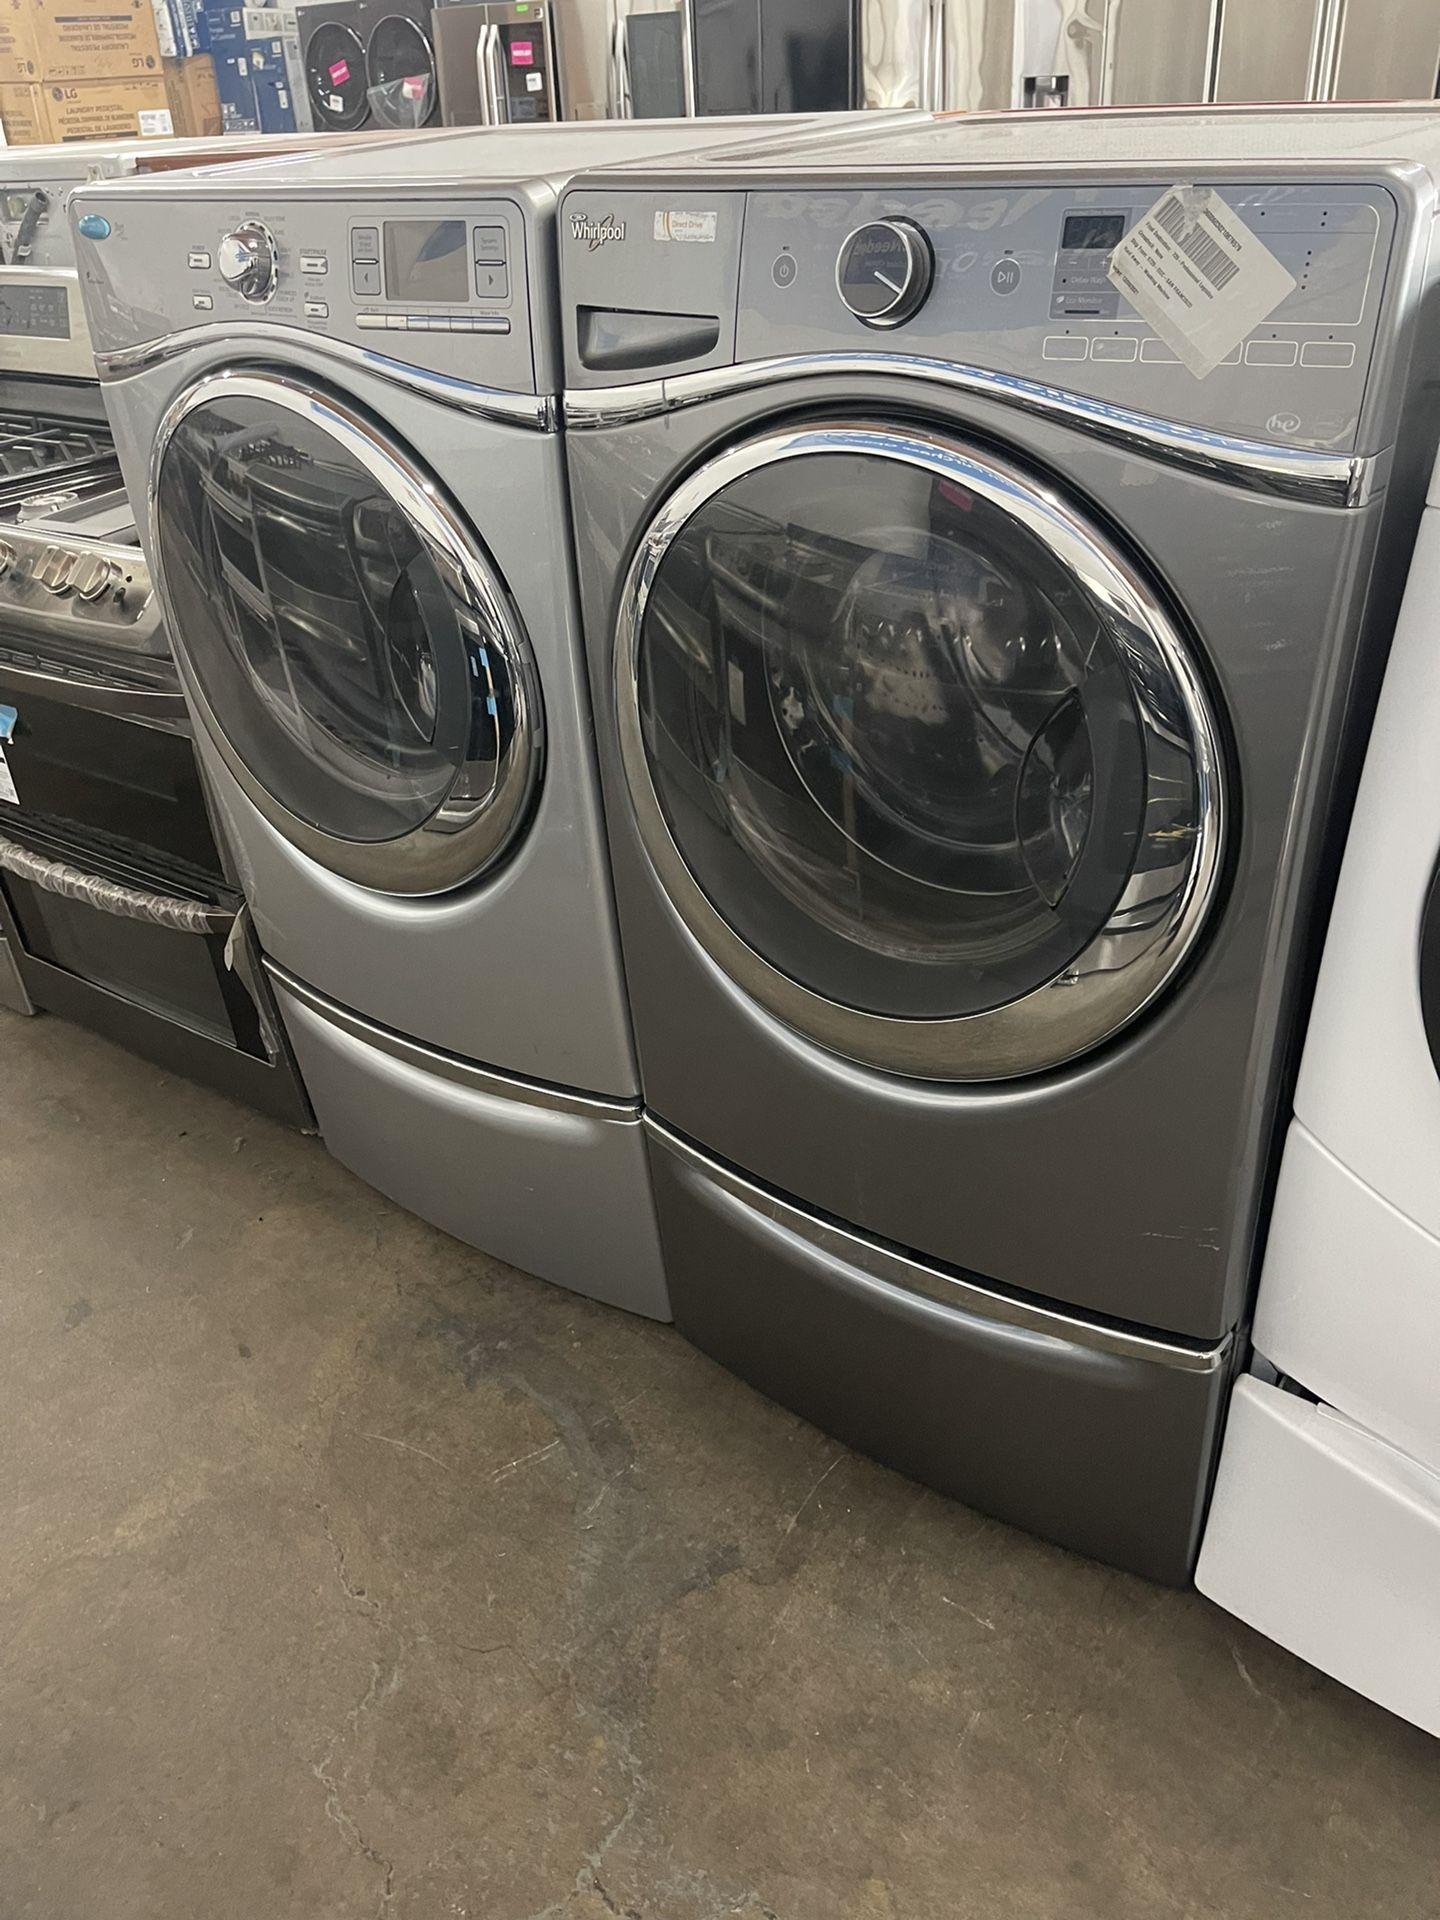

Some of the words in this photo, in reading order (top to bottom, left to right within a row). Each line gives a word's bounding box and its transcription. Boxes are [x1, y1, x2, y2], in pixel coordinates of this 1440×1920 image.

[132, 58, 145, 68] LG
[64, 88, 78, 100] LG
[66, 106, 94, 114] LAUNDRY
[689, 220, 703, 229] Drive
[571, 221, 626, 245] Whirlpool
